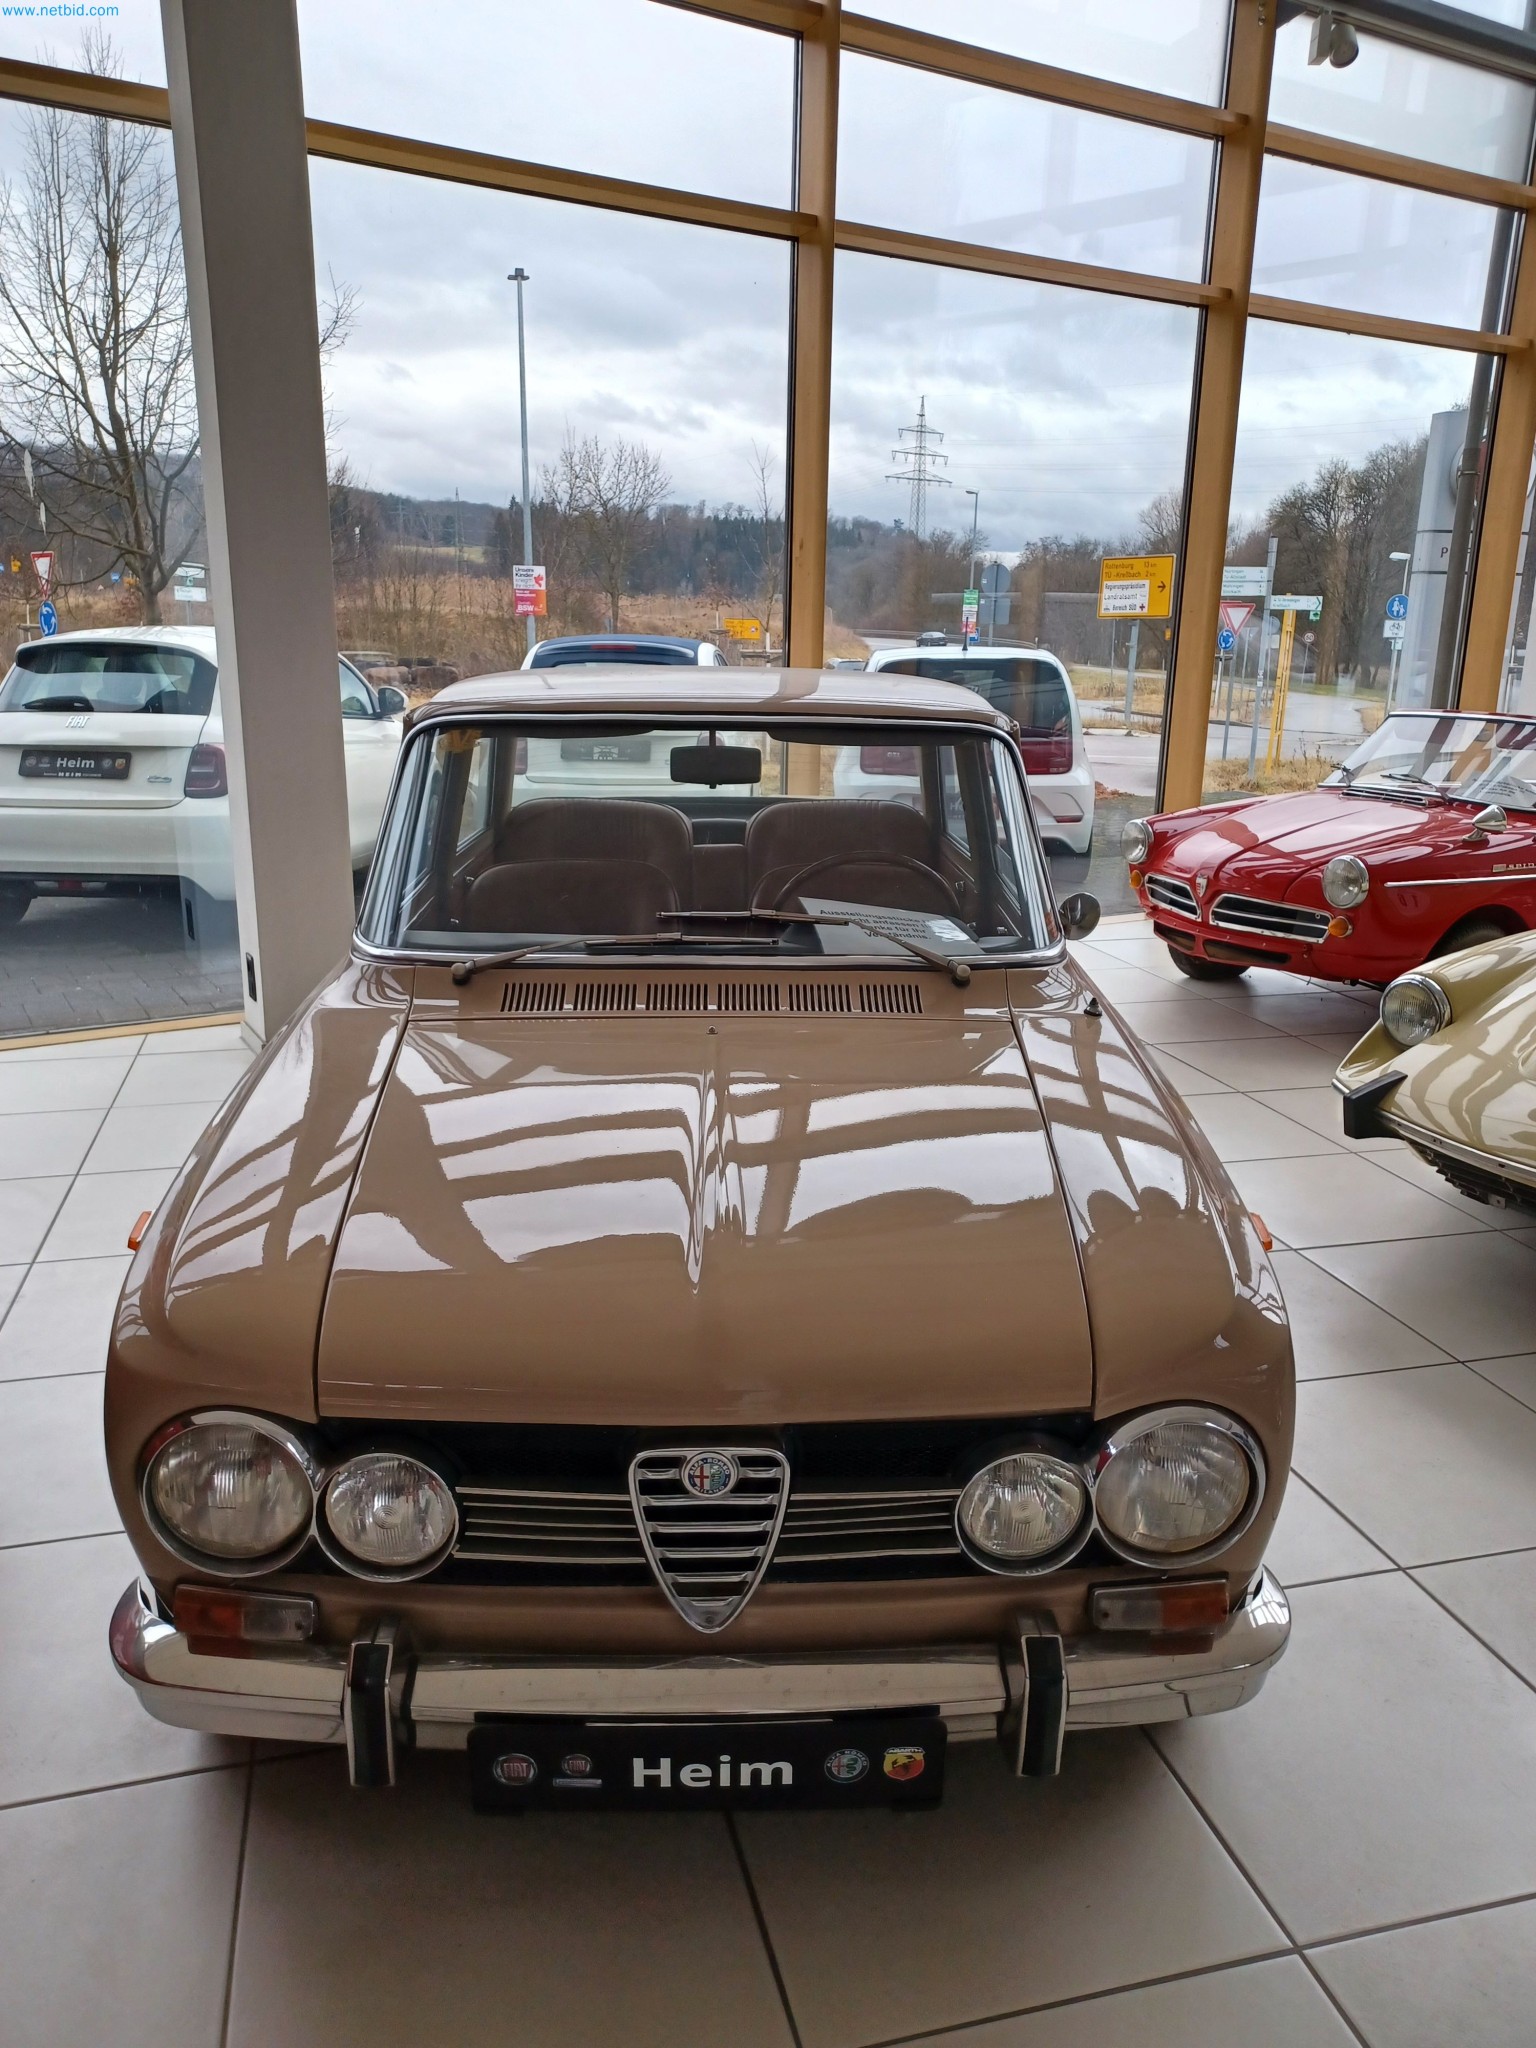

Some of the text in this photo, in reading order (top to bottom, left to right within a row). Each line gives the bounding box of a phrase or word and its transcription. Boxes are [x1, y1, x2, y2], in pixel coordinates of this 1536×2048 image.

[1105, 562, 1134, 570] Rottenburg
[65, 715, 91, 728] FIAT
[56, 757, 95, 768] Heim
[820, 909, 921, 923] Ausstellungsstücke
[873, 919, 919, 928] anfassen
[864, 931, 932, 939] Vetändnis.
[503, 1762, 529, 1777] FIAT
[632, 1754, 793, 1788] Heim
